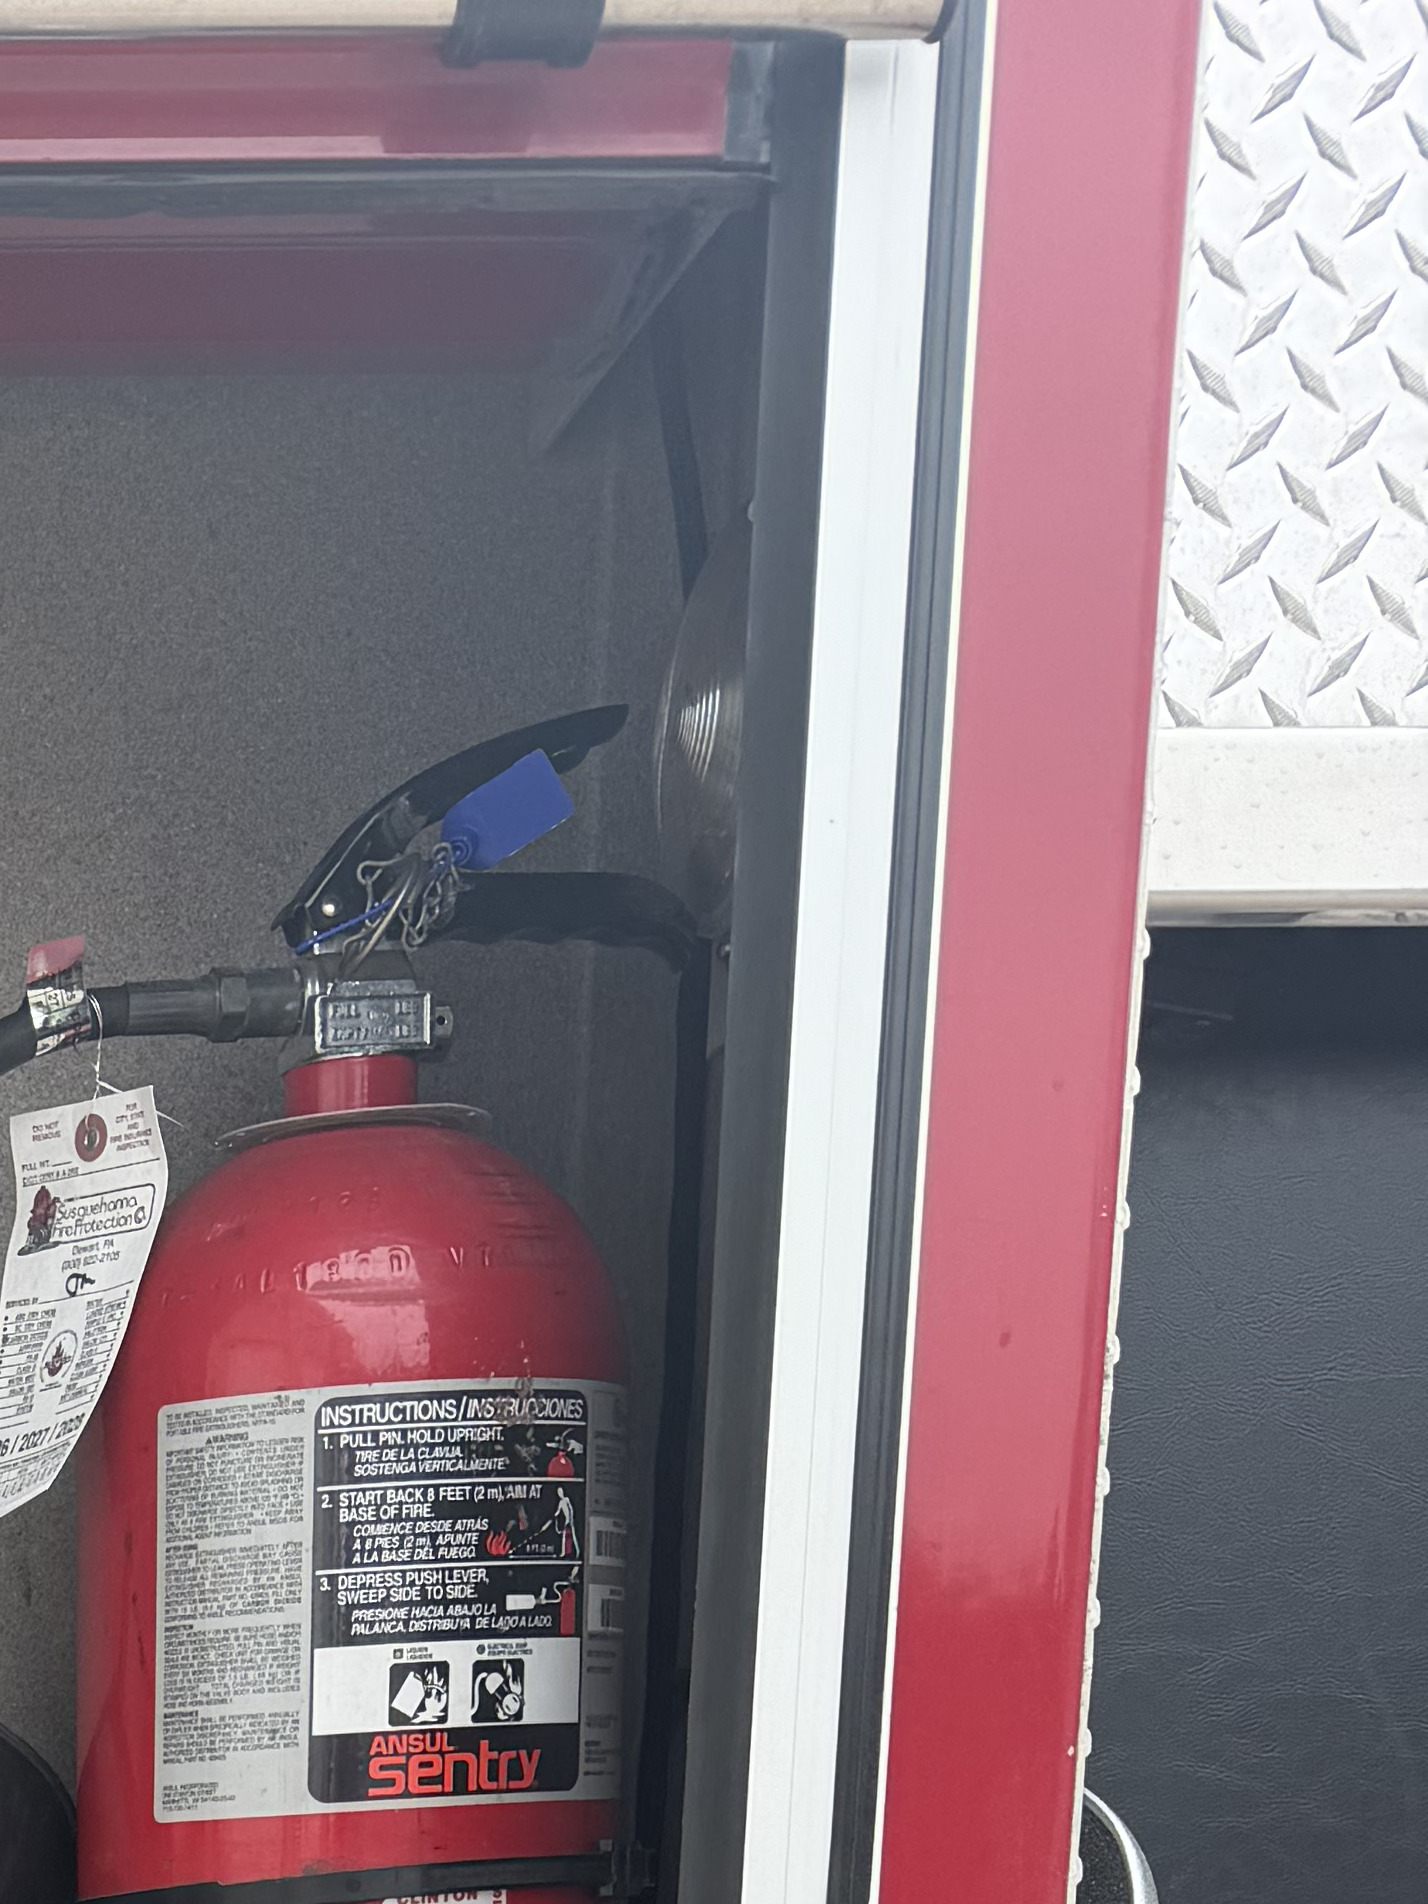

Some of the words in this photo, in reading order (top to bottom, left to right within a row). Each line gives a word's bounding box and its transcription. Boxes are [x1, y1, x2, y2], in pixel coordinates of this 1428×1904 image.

[19, 1430, 50, 1451] 2027
[340, 1433, 377, 1448] PULL
[407, 1430, 444, 1444] HOLD
[446, 1427, 504, 1442] UPRIGHT.
[384, 1449, 400, 1461] DE
[401, 1448, 416, 1460] LA
[354, 1462, 416, 1477] SOSTENGA
[339, 1490, 384, 1506] START
[386, 1489, 424, 1504] BACK
[427, 1490, 435, 1502] 8
[439, 1486, 471, 1500] FEET
[528, 1484, 542, 1499] AT
[339, 1506, 381, 1523] BASE
[383, 1506, 401, 1519] OF
[402, 1504, 434, 1518] FIRE.
[415, 1520, 453, 1534] DESDE
[353, 1538, 362, 1550] A
[352, 1552, 362, 1564] A
[364, 1552, 380, 1563] LA
[382, 1550, 416, 1562] BASE
[415, 1549, 436, 1561] DEL
[338, 1572, 403, 1590] DEPRESS
[405, 1571, 442, 1584] PUSH
[338, 1588, 387, 1605] SWEEP
[389, 1586, 422, 1601] SIDE
[426, 1586, 443, 1599] TO
[483, 1603, 496, 1615] LA
[475, 1616, 490, 1630] DE
[369, 1732, 455, 1755] ANSUL
[367, 1740, 542, 1797] sentry
